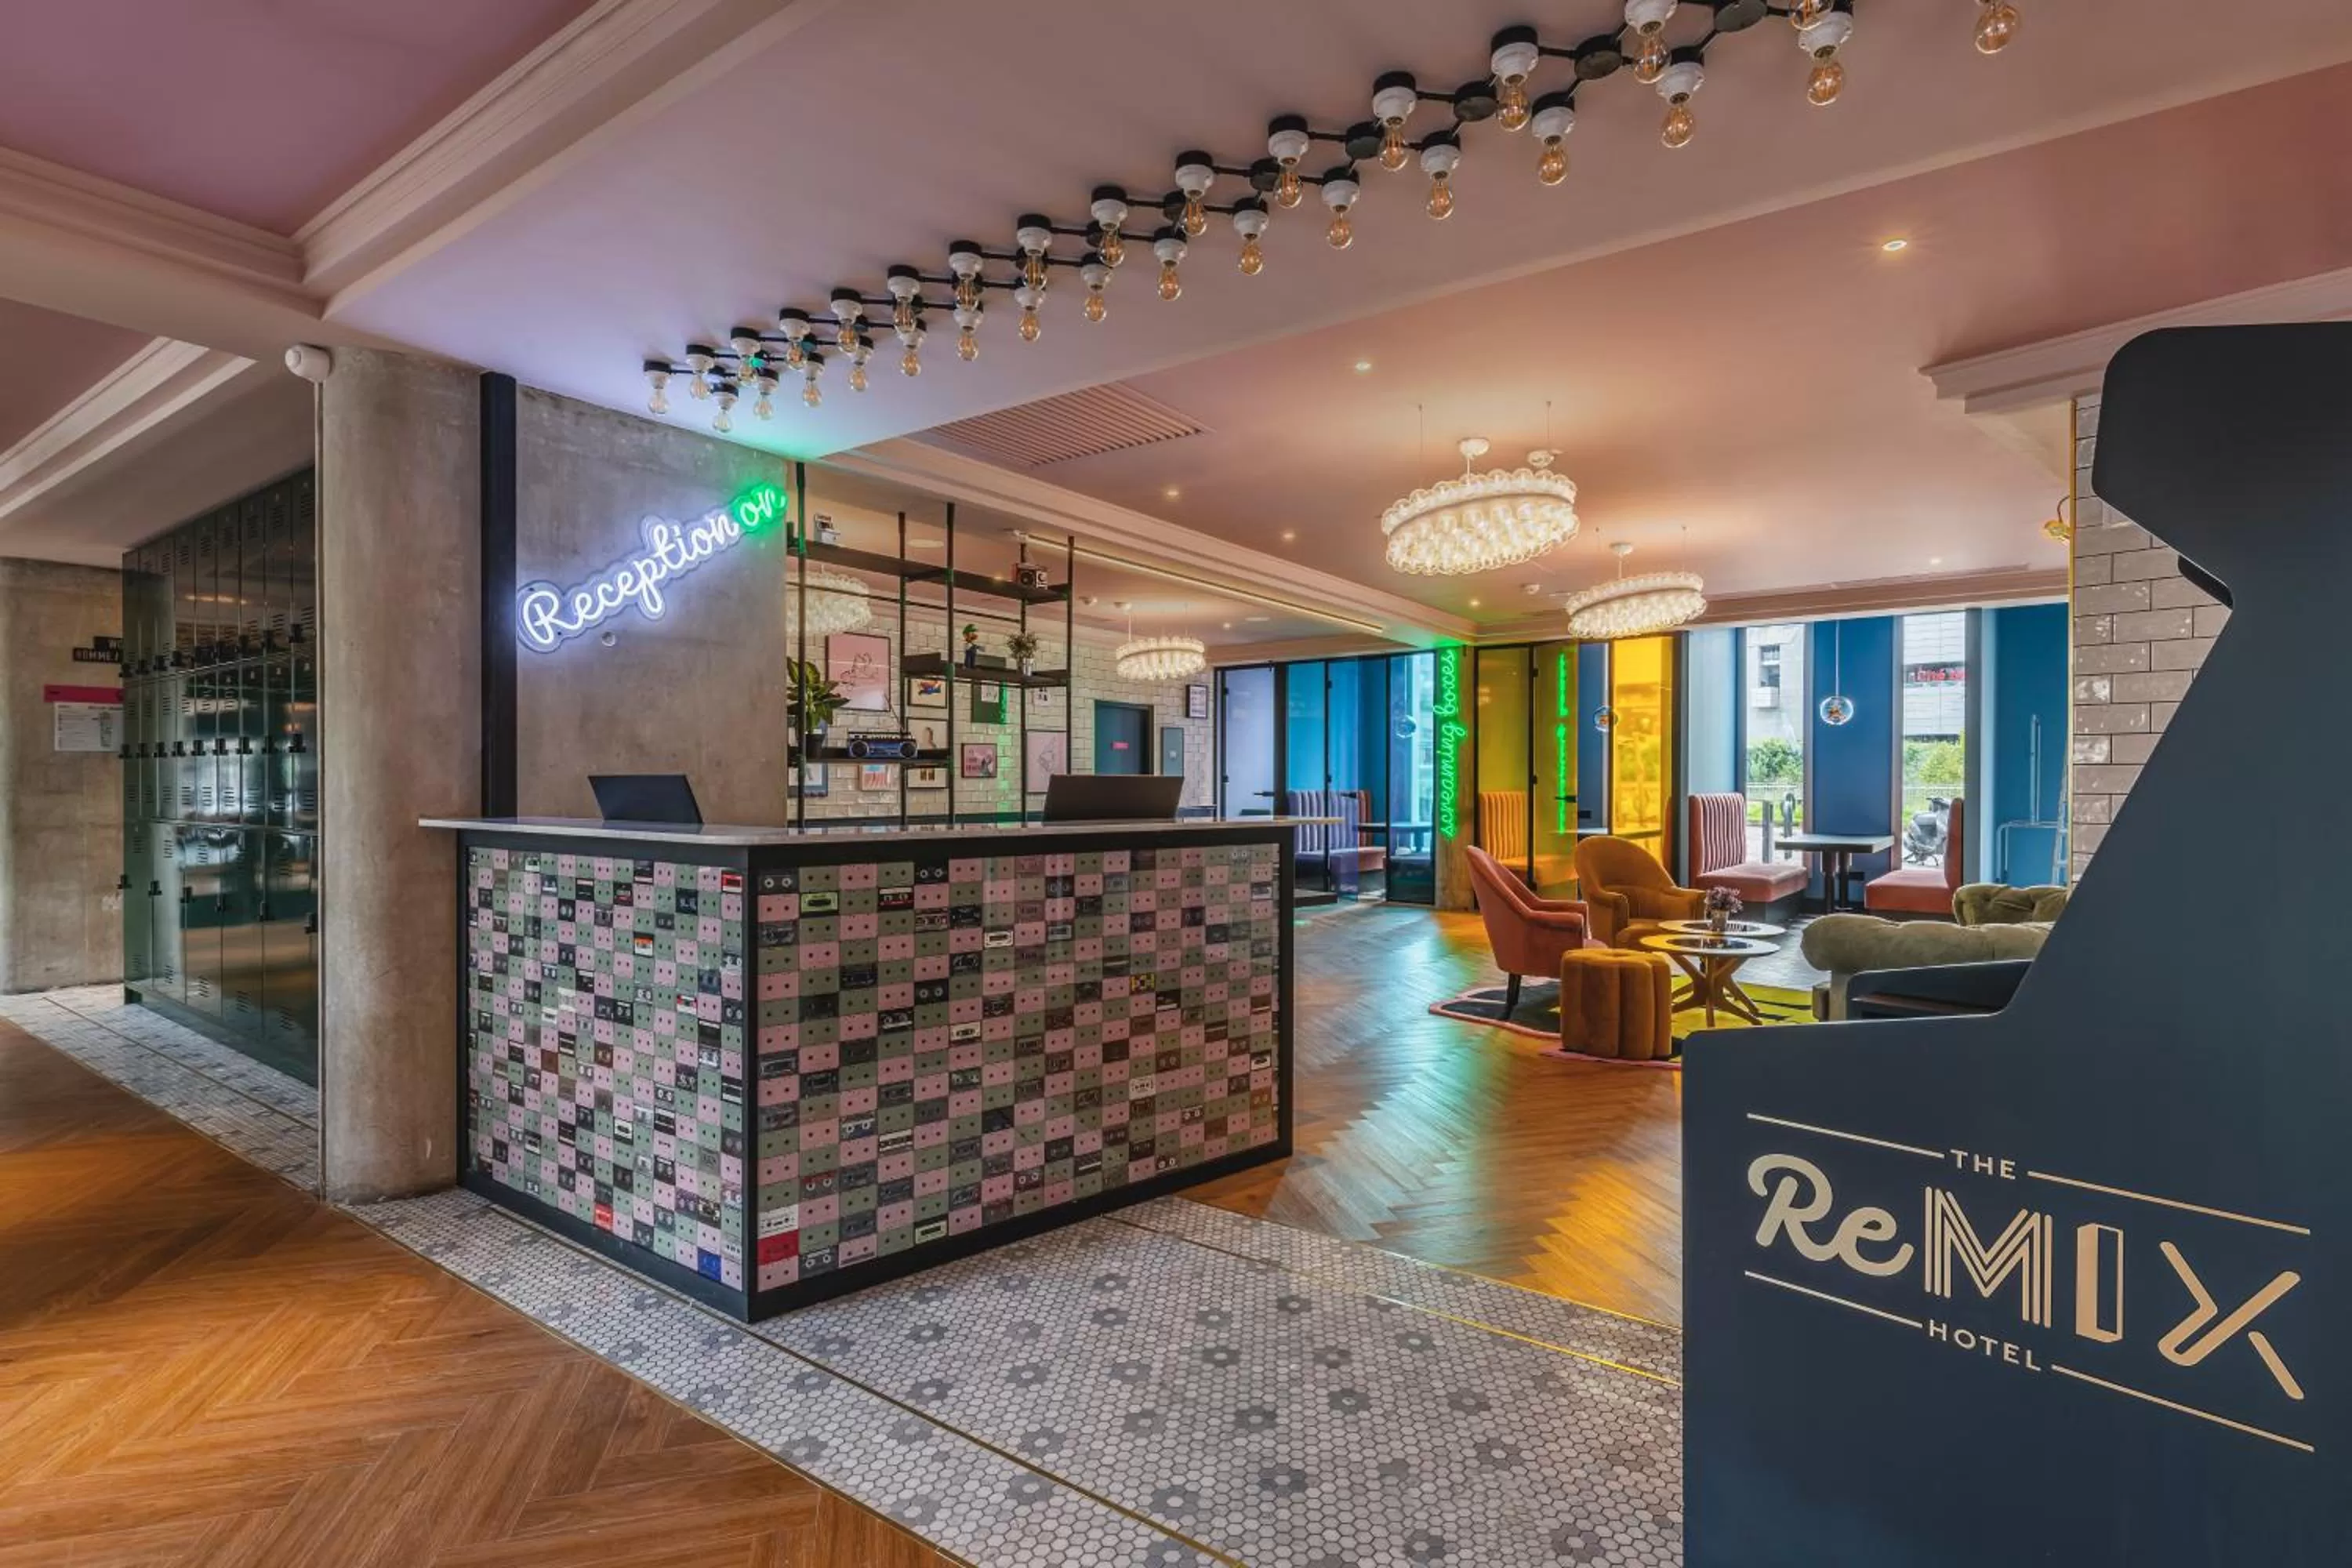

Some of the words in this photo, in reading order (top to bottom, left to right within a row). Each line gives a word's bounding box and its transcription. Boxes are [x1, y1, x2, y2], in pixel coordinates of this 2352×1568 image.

[523, 514, 739, 644] Reception
[739, 488, 786, 527] on
[1433, 649, 1458, 717] boxes
[1436, 721, 1466, 838] screaming
[1950, 1149, 2016, 1181] THE
[1748, 1153, 2305, 1401] ReMIX
[1929, 1319, 2042, 1372] HOTEL
